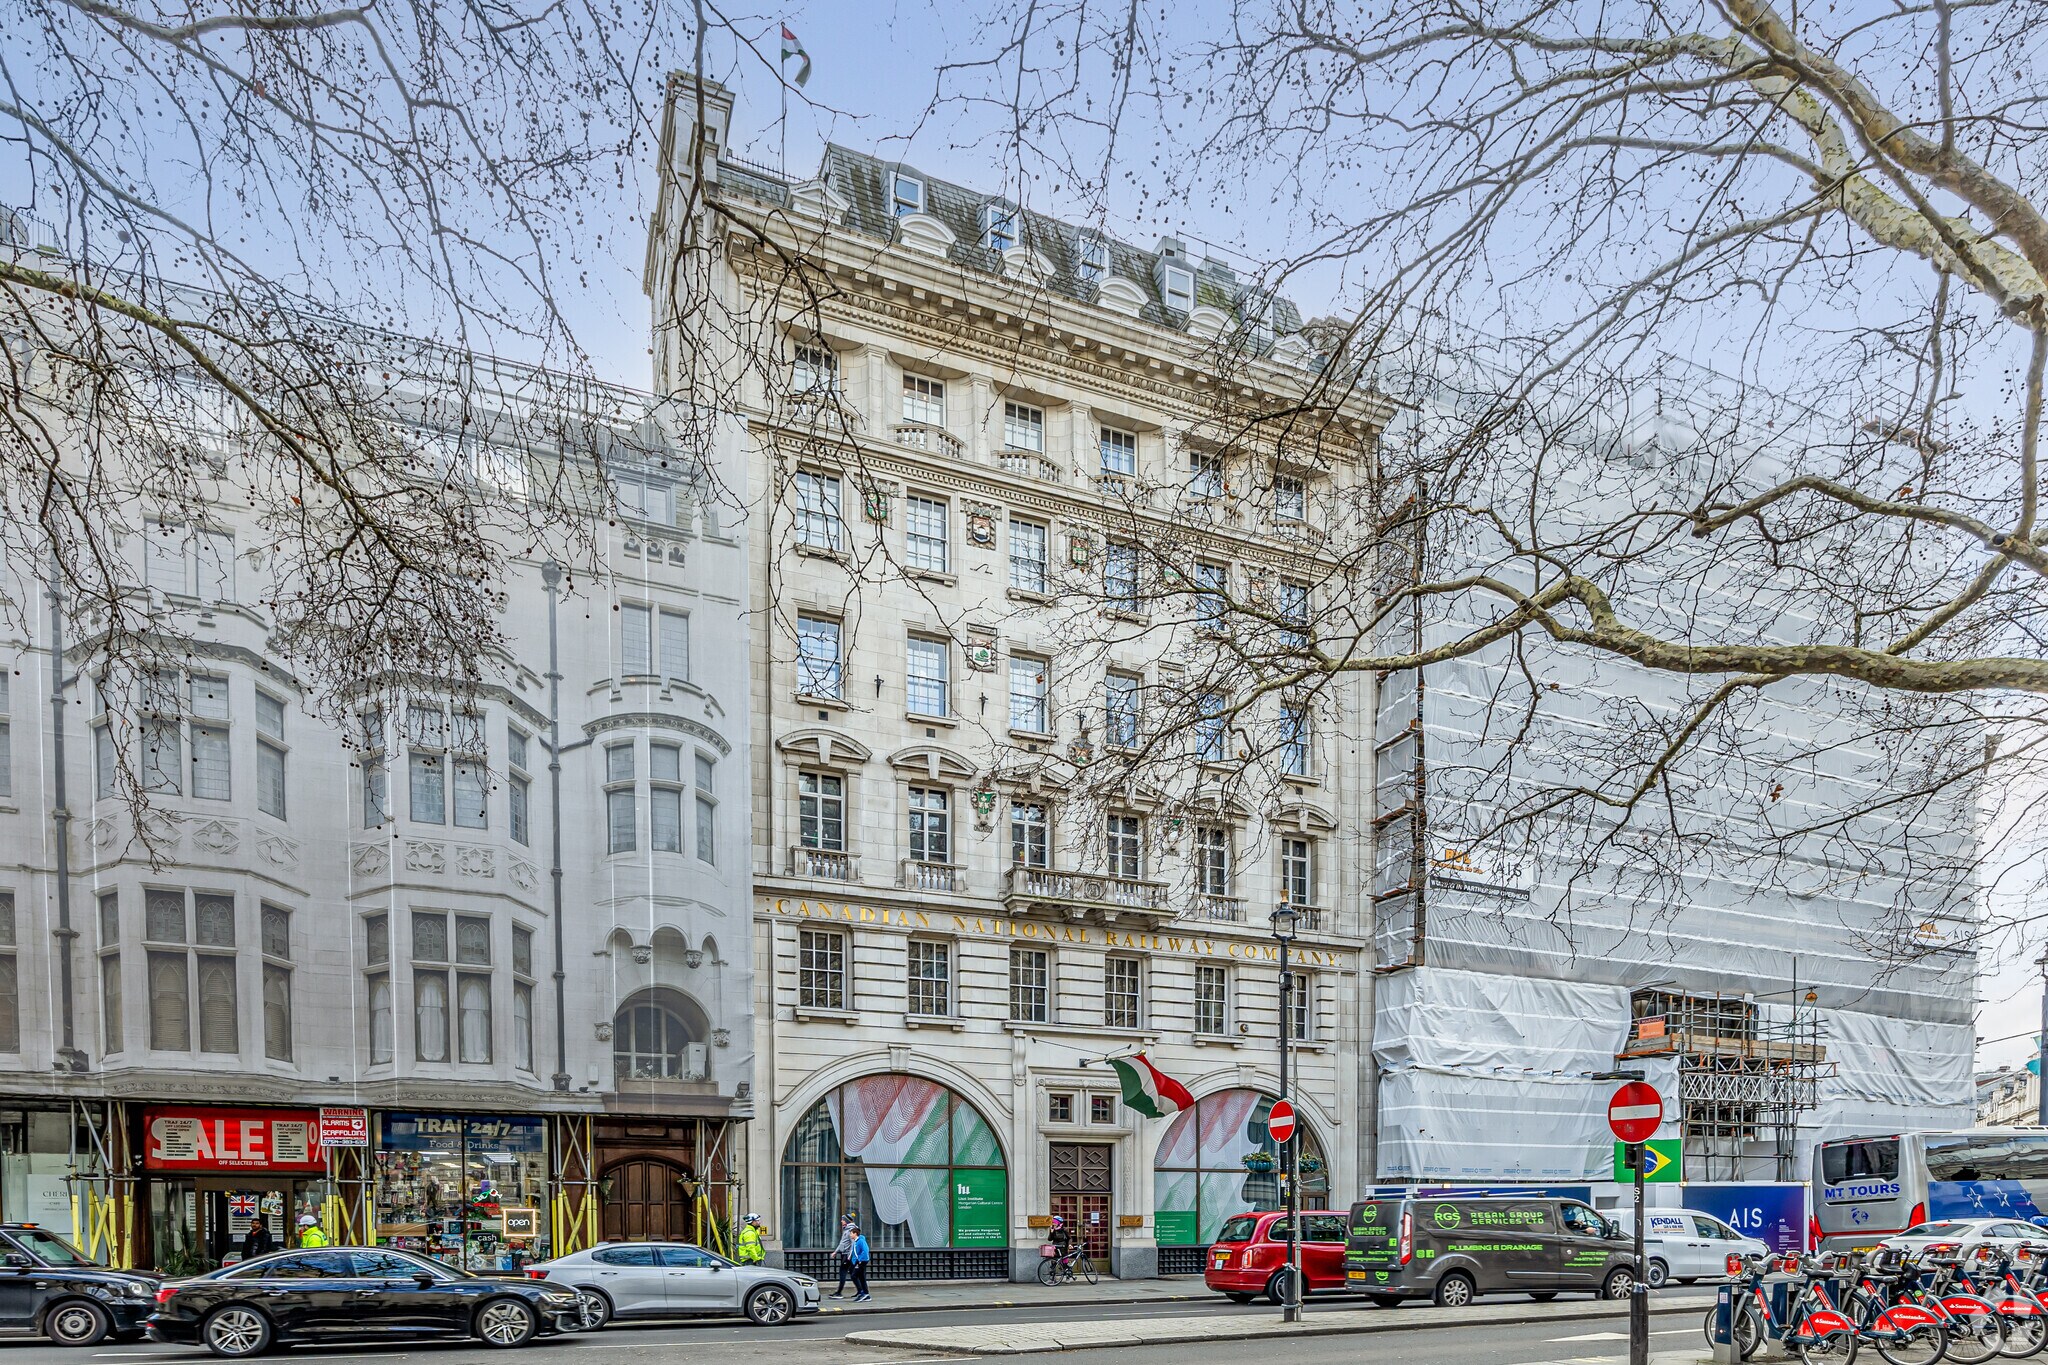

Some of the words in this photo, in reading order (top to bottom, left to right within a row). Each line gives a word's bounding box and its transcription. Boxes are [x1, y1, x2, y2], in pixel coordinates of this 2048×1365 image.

[952, 916, 1090, 943] NATIONAL
[1104, 929, 1216, 955] RAILWAY
[471, 1119, 511, 1137] 24/7
[322, 1129, 366, 1137] SCAFFOLDING
[430, 1140, 454, 1149] Food
[456, 1141, 463, 1149] &
[467, 1140, 499, 1150] Drinks
[1824, 1187, 1845, 1198] MT
[1848, 1183, 1901, 1197] TOURS
[1434, 1212, 1460, 1221] RGS
[1728, 1207, 1763, 1228] AIS
[508, 1218, 530, 1227] open
[1650, 1217, 1683, 1228] KENDALL
[477, 1234, 497, 1242] cash
[1899, 1313, 1926, 1321] Santander
[1819, 1318, 1841, 1326] Santander
